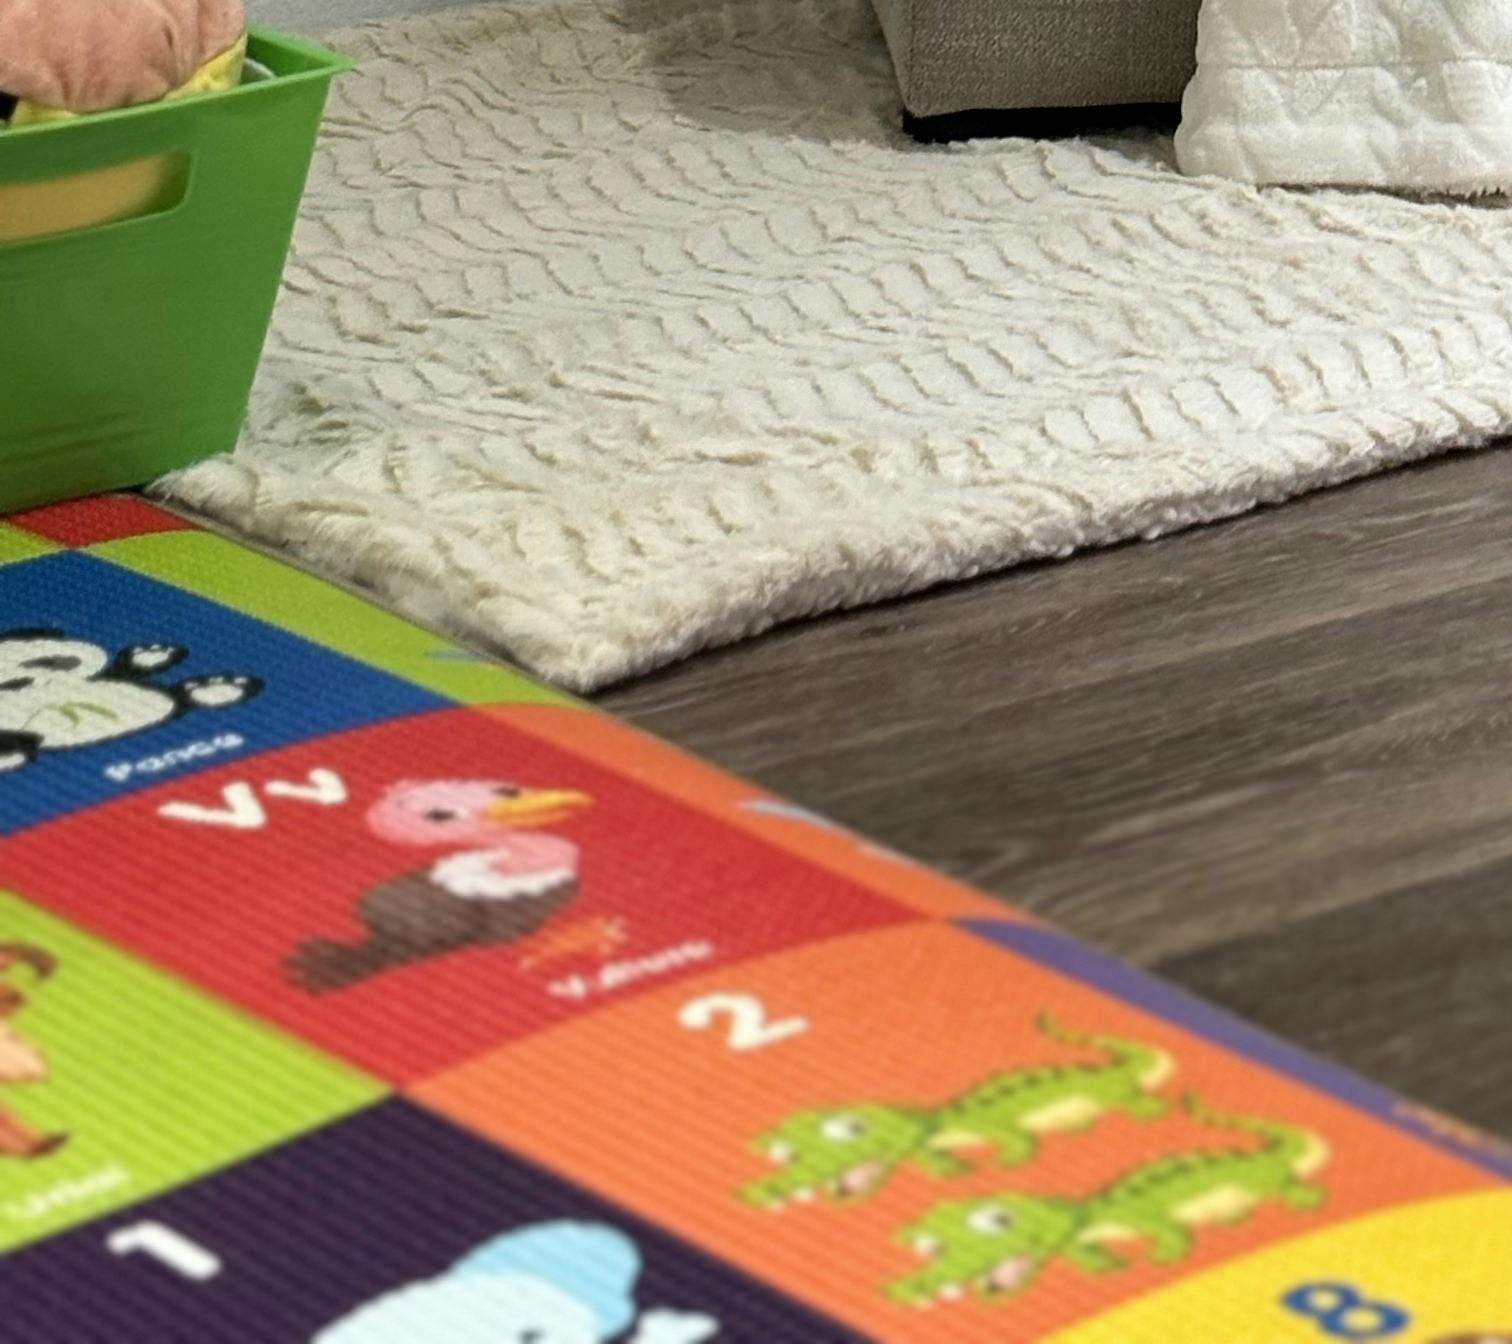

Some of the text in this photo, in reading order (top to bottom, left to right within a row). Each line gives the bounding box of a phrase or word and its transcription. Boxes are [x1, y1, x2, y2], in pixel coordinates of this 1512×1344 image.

[678, 992, 806, 1051] 2
[108, 1222, 222, 1280] 1
[1281, 1281, 1409, 1339] 8
